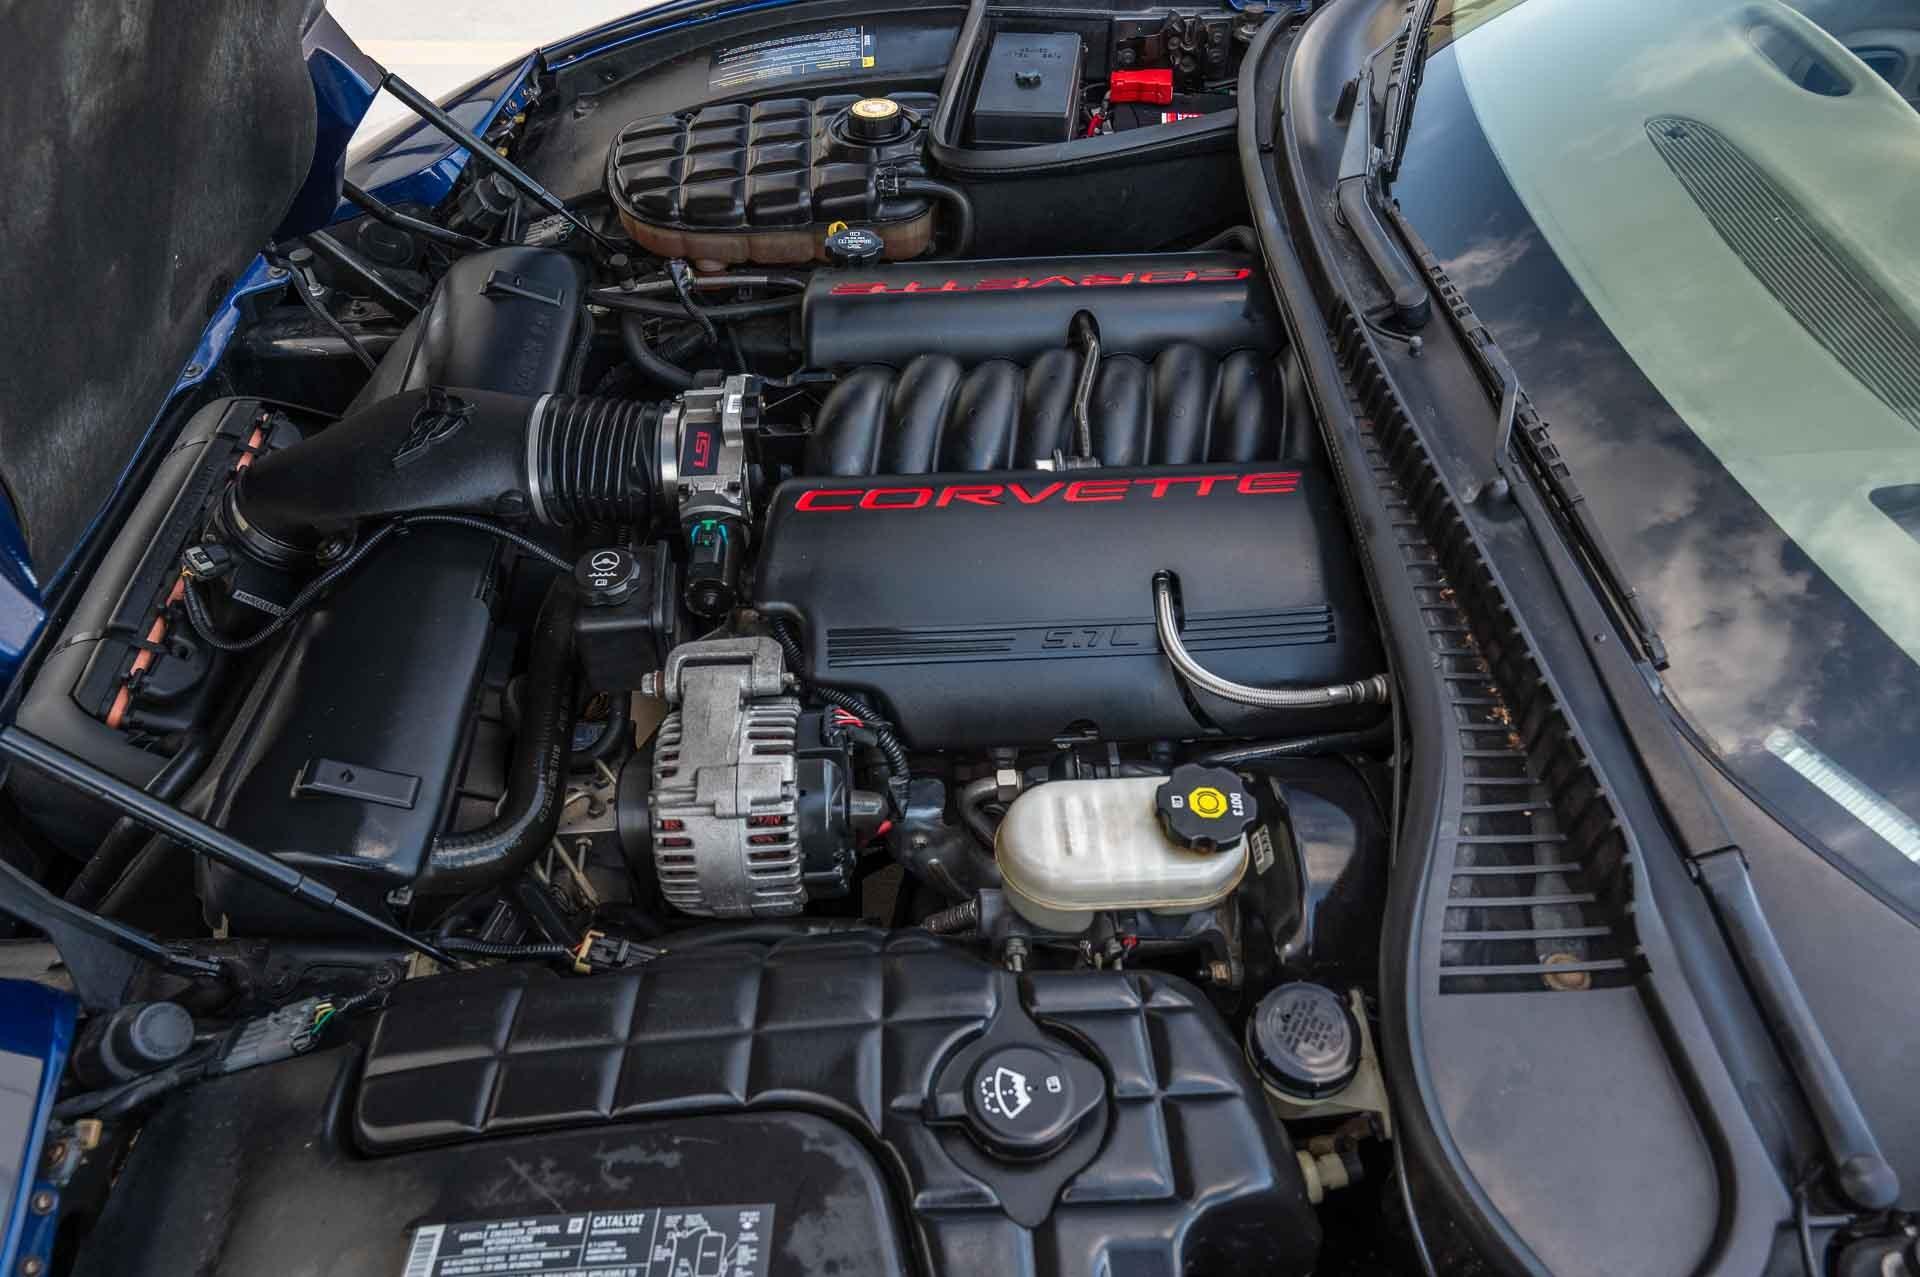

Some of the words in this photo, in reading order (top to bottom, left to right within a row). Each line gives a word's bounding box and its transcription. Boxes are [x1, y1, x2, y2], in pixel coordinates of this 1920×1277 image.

[828, 267, 1252, 296] CORVETTE
[794, 472, 1301, 511] CORVETTE
[1041, 626, 1139, 650] 5.7L
[592, 1213, 645, 1228] CATALYST
